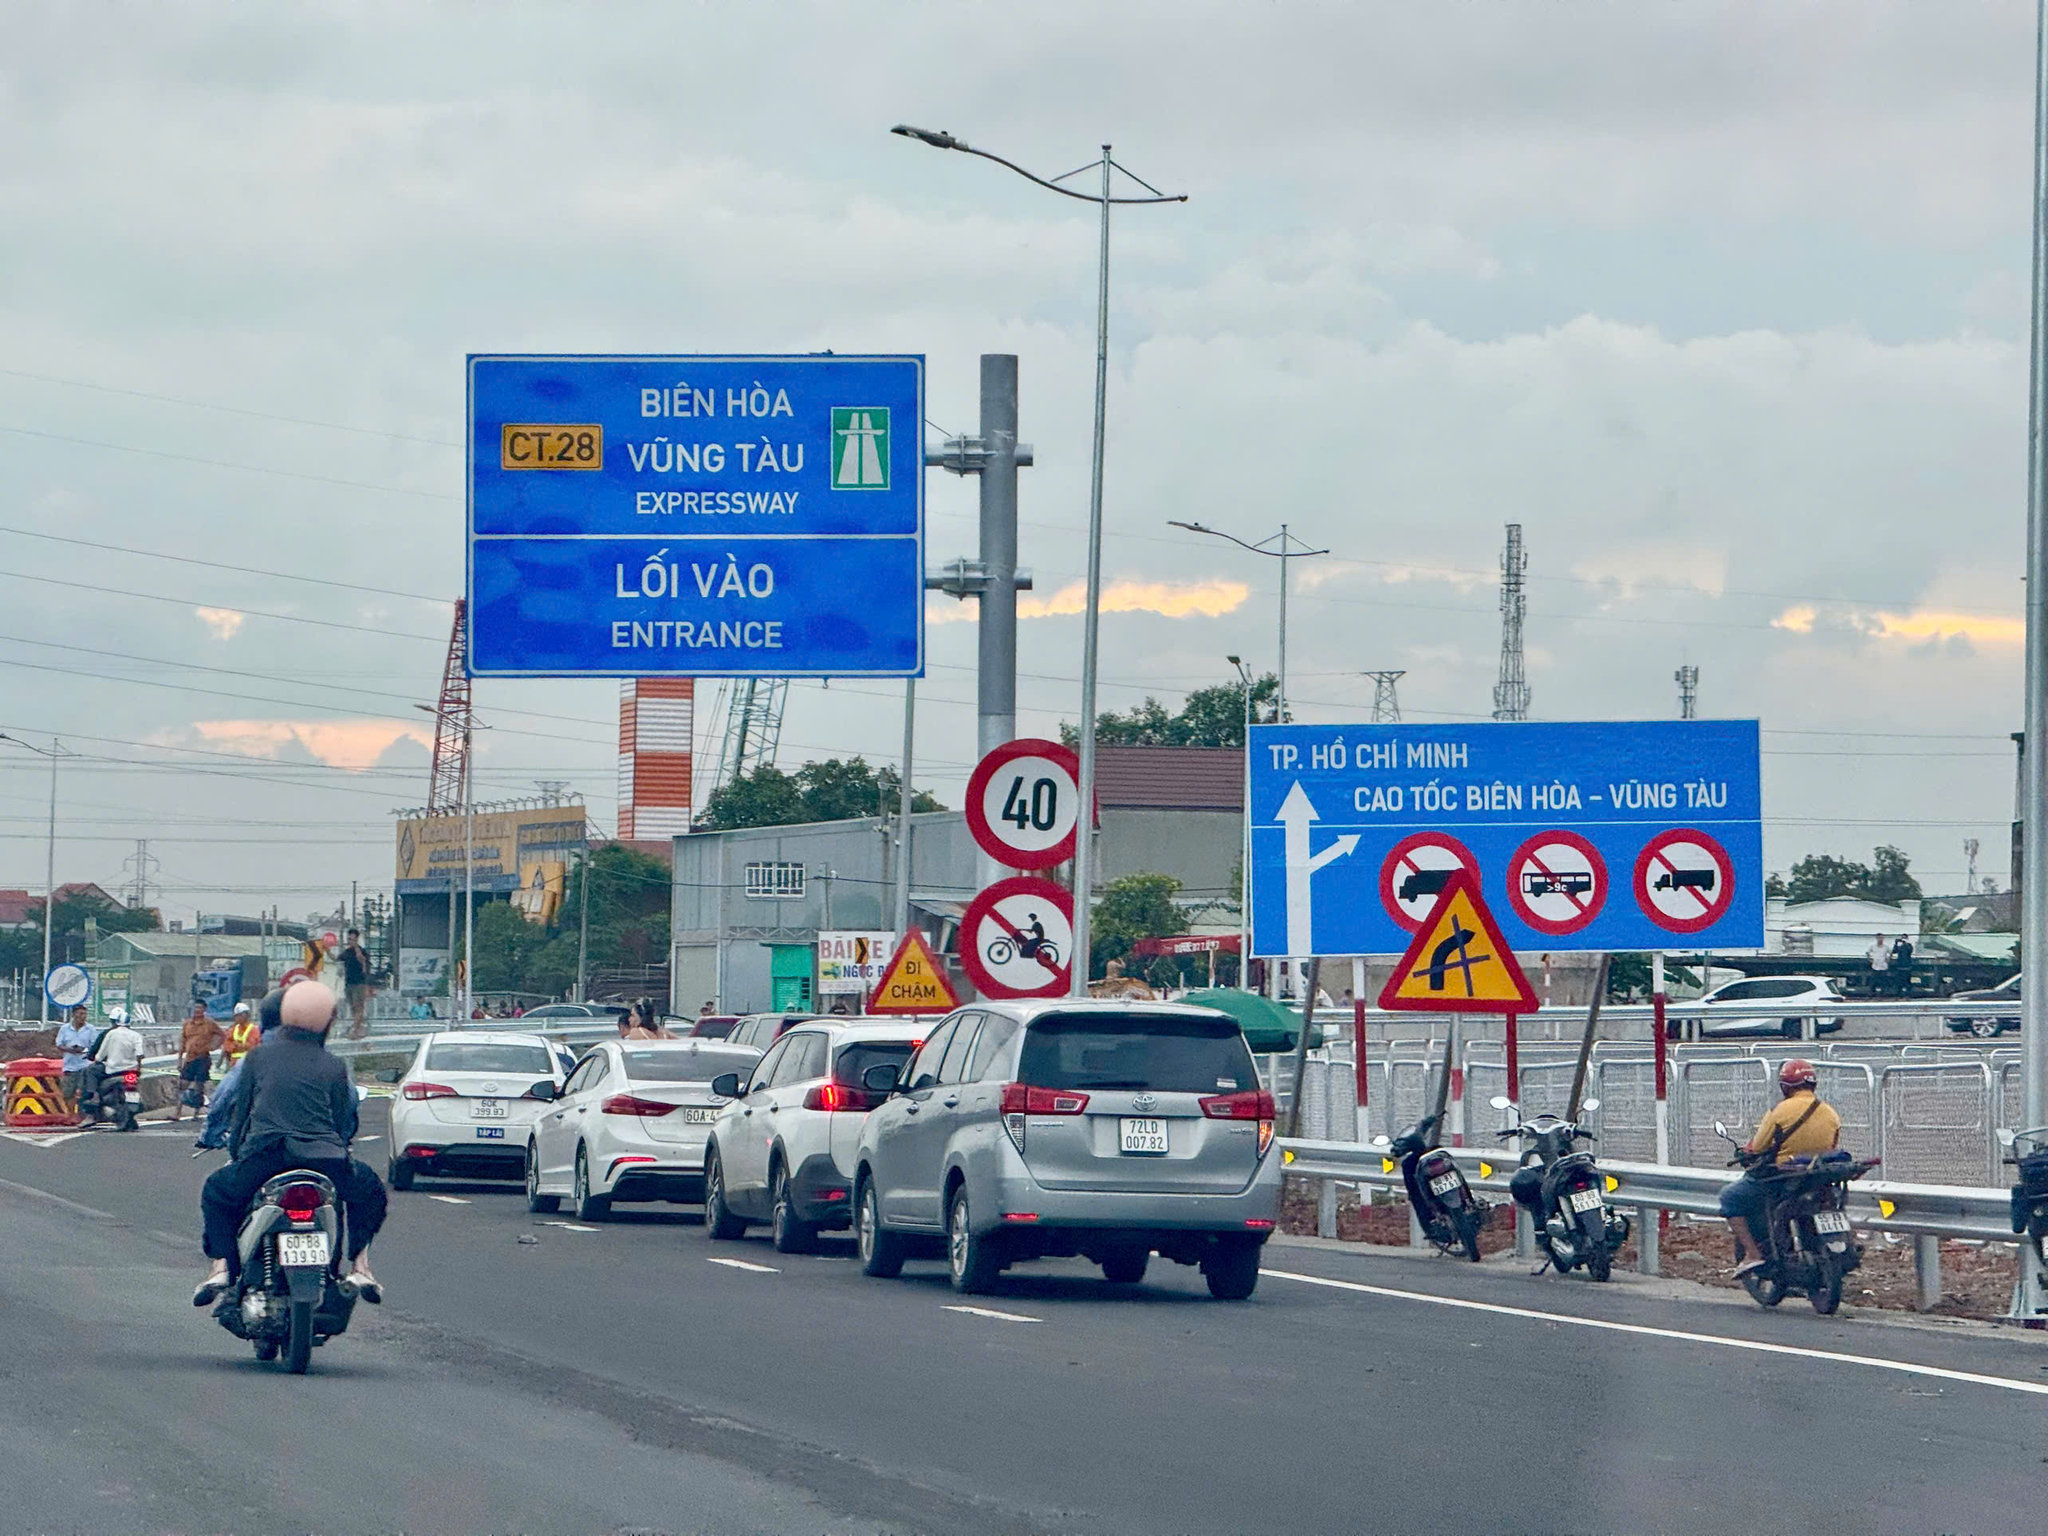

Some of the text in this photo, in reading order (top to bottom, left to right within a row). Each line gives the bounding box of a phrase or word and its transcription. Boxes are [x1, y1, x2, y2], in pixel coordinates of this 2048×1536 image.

[640, 381, 794, 417] BIÊN HÒA
[508, 432, 595, 462] CT.28
[627, 436, 804, 473] VŨNG TÀU
[636, 491, 799, 514] EXPRESSWAY
[616, 548, 774, 599] LỐI VÀO
[612, 621, 783, 648] ENTRANCE
[1269, 735, 1468, 770] TP. HỒ CHÍ MINH
[1001, 776, 1058, 831] 40
[1354, 786, 1403, 812] CAO
[1410, 780, 1458, 811] TỐC
[1467, 781, 1522, 811] BIÊN
[1531, 780, 1582, 810] HÒA
[1609, 780, 1677, 809] VŨNG
[1683, 777, 1728, 808] TÀU
[820, 936, 853, 959] BÃI
[906, 961, 921, 975] ĐI
[891, 982, 936, 1002] CHẬM
[1129, 1120, 1158, 1134] 72LD
[1126, 1136, 1163, 1150] 007.82
